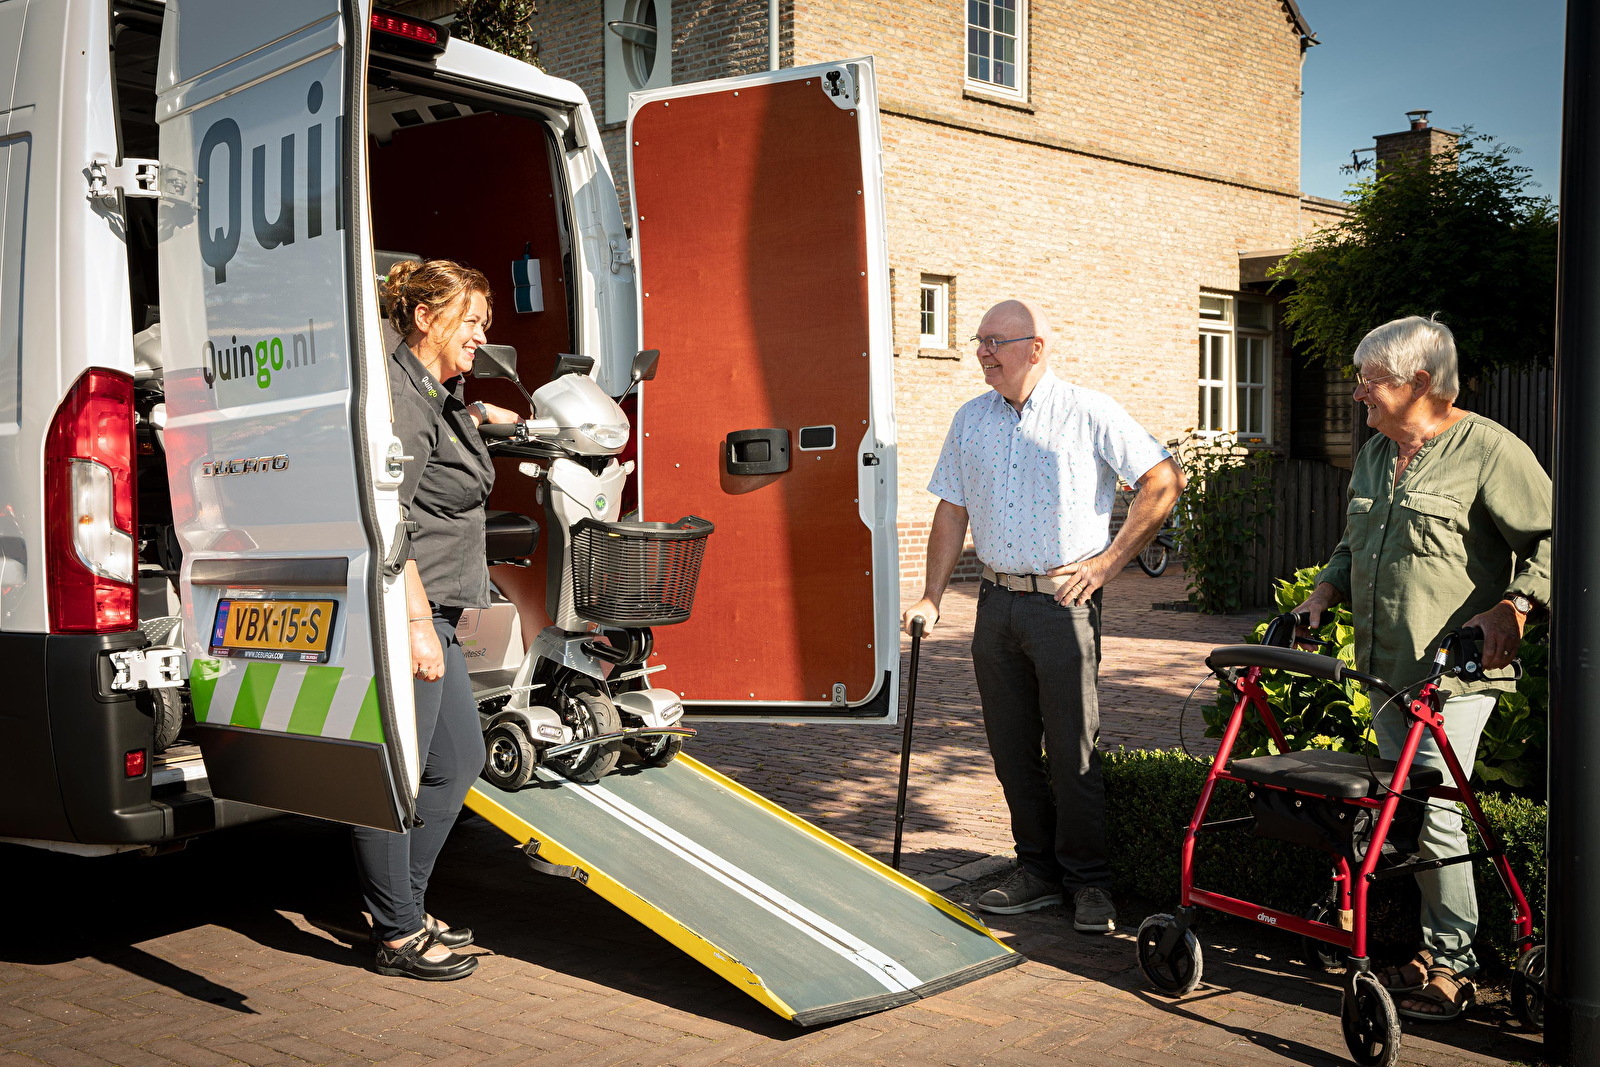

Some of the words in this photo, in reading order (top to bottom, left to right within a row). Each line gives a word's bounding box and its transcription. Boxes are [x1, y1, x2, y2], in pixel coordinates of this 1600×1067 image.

[202, 318, 316, 389] Quingo.nl
[421, 375, 438, 398] Quingo
[201, 453, 290, 477] DUCATO
[235, 606, 322, 643] VBX-15-S
[1257, 912, 1277, 924] drive
